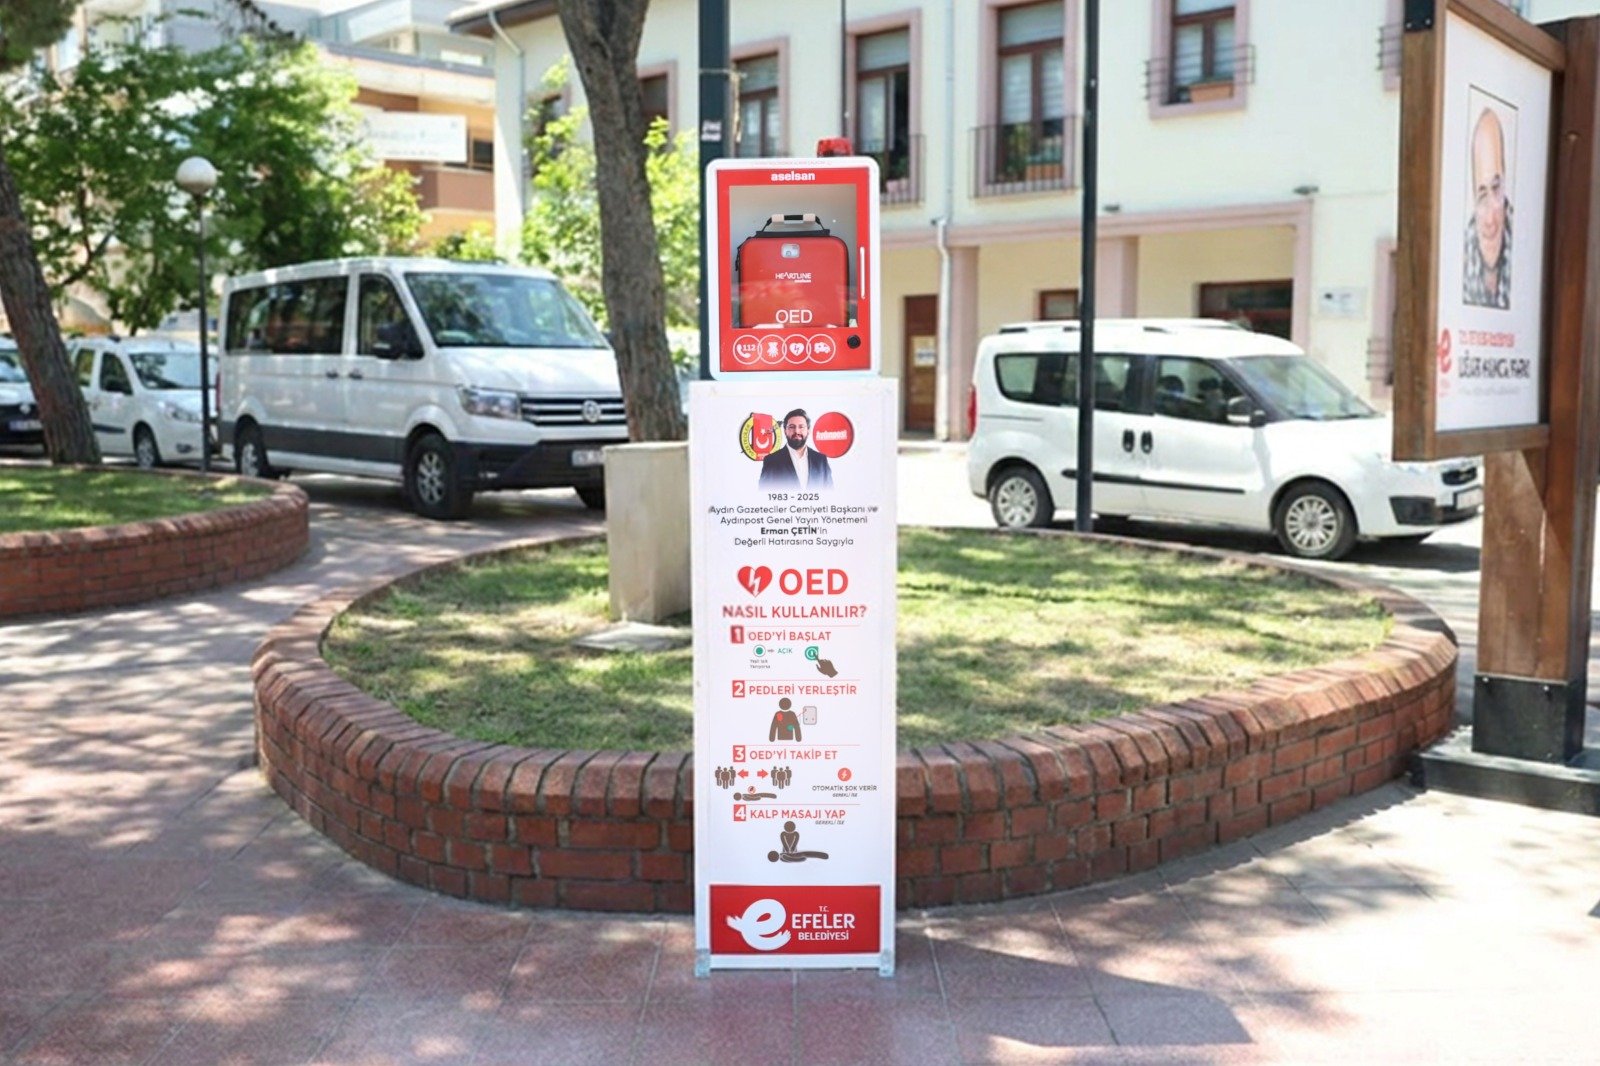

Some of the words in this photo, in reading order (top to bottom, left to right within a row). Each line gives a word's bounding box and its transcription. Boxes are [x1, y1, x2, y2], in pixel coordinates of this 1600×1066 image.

[771, 171, 816, 181] aselsan
[775, 309, 813, 324] OED
[743, 344, 756, 352] 112
[768, 493, 788, 501] 1983
[797, 493, 820, 501] 2025
[709, 506, 735, 515] Aydın
[737, 505, 787, 514] Gazeteciler
[789, 505, 828, 515] Cemiyeti
[831, 505, 866, 515] Başkanı
[720, 516, 764, 525] Aydınpost
[766, 516, 793, 524] Genel
[796, 516, 819, 525] Yayın
[821, 516, 868, 524] Yönetmeni
[760, 527, 789, 535] Erman
[734, 537, 766, 547] Değerli
[768, 537, 814, 546] Hatırasına
[816, 537, 854, 547] Saygıyla
[779, 568, 849, 595] OED
[722, 605, 768, 618] NASIL
[771, 605, 867, 618] KULLANILIR?
[789, 631, 832, 642] BAŞLAT
[777, 647, 793, 655] AÇIK
[733, 681, 744, 696] 2
[749, 683, 795, 695] PEDLERİ
[798, 683, 857, 696] YERLEŞTİR
[734, 746, 744, 760] 3
[790, 749, 822, 760] TAKİP
[824, 750, 837, 760] ET
[812, 784, 844, 792] OTOMATİK
[845, 785, 858, 793] ŞOK
[734, 805, 746, 820] 4
[750, 809, 779, 819] KALP
[781, 809, 822, 819] MASAJI
[824, 809, 846, 819] YAP
[791, 913, 855, 929] EFELER
[798, 931, 849, 941] BELEDİYESİ
